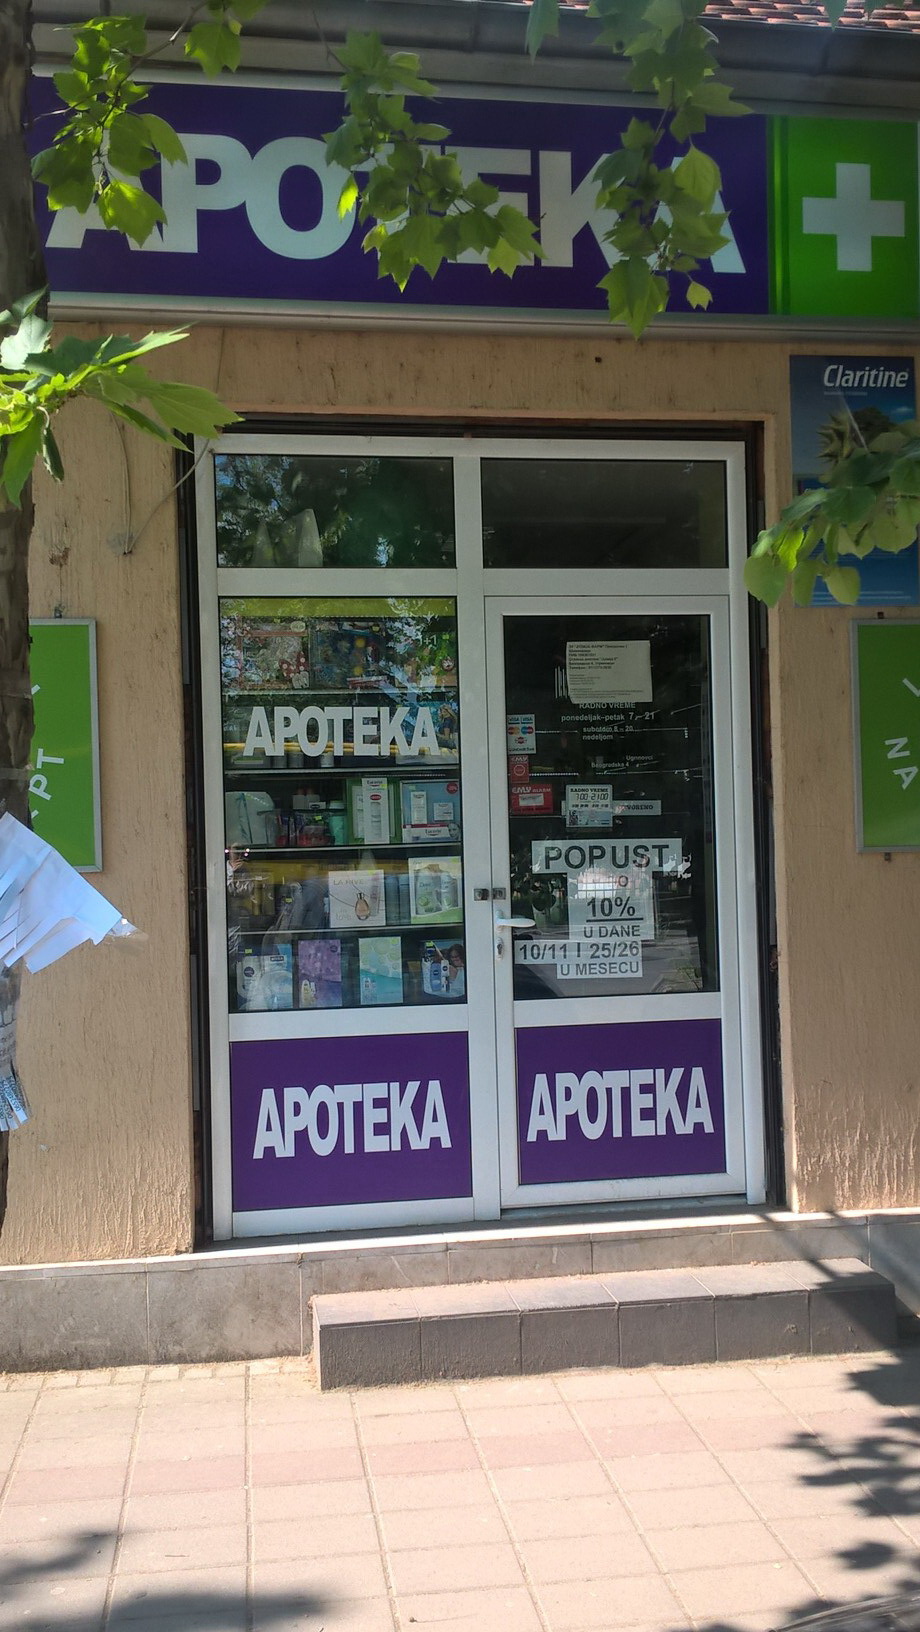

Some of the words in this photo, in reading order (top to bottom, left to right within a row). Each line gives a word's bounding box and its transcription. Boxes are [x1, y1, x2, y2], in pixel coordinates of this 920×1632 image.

[823, 364, 909, 388] Claritine
[609, 701, 636, 709] VREME
[628, 712, 635, 721] 7
[644, 712, 655, 720] 21
[243, 705, 440, 757] APOTEKA
[544, 844, 670, 870] POPUST
[586, 896, 636, 917] 10%
[583, 926, 593, 939] U
[599, 924, 641, 938] DANE
[519, 942, 567, 960] 10/11
[590, 940, 639, 959] 25/26
[560, 962, 570, 976] U
[576, 961, 639, 976] MESECU
[526, 1066, 715, 1143] APOTEKA
[252, 1079, 453, 1160] APOTEKA
